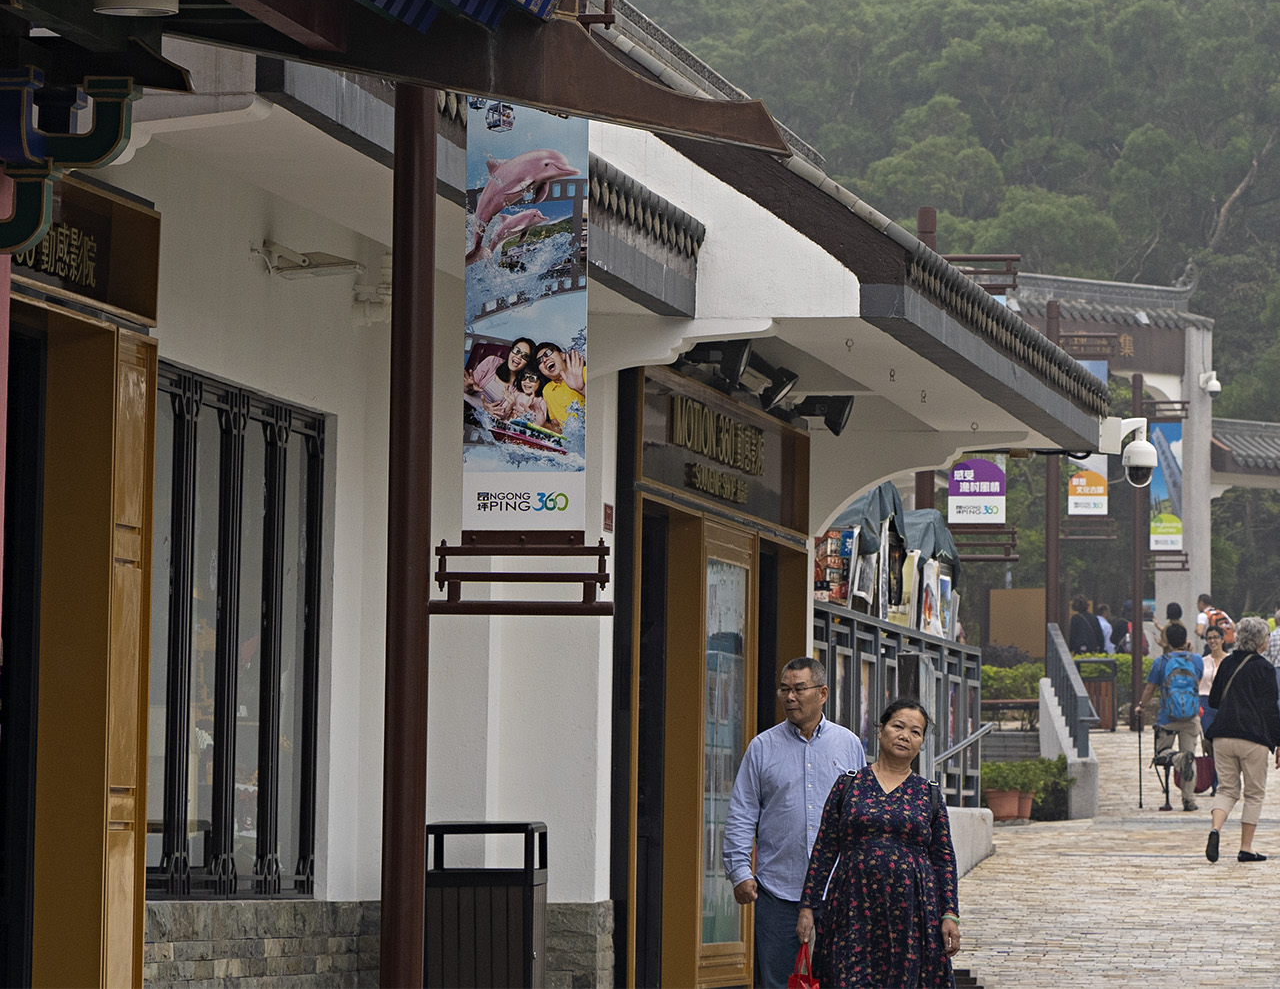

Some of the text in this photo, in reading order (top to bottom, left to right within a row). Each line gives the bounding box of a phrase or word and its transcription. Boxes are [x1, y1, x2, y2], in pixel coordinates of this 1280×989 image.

[673, 395, 717, 459] MOTION
[718, 413, 735, 466] 360
[489, 492, 531, 501] NGONG
[531, 491, 569, 512] 360
[489, 501, 531, 512] PING
[982, 505, 999, 515] 360
